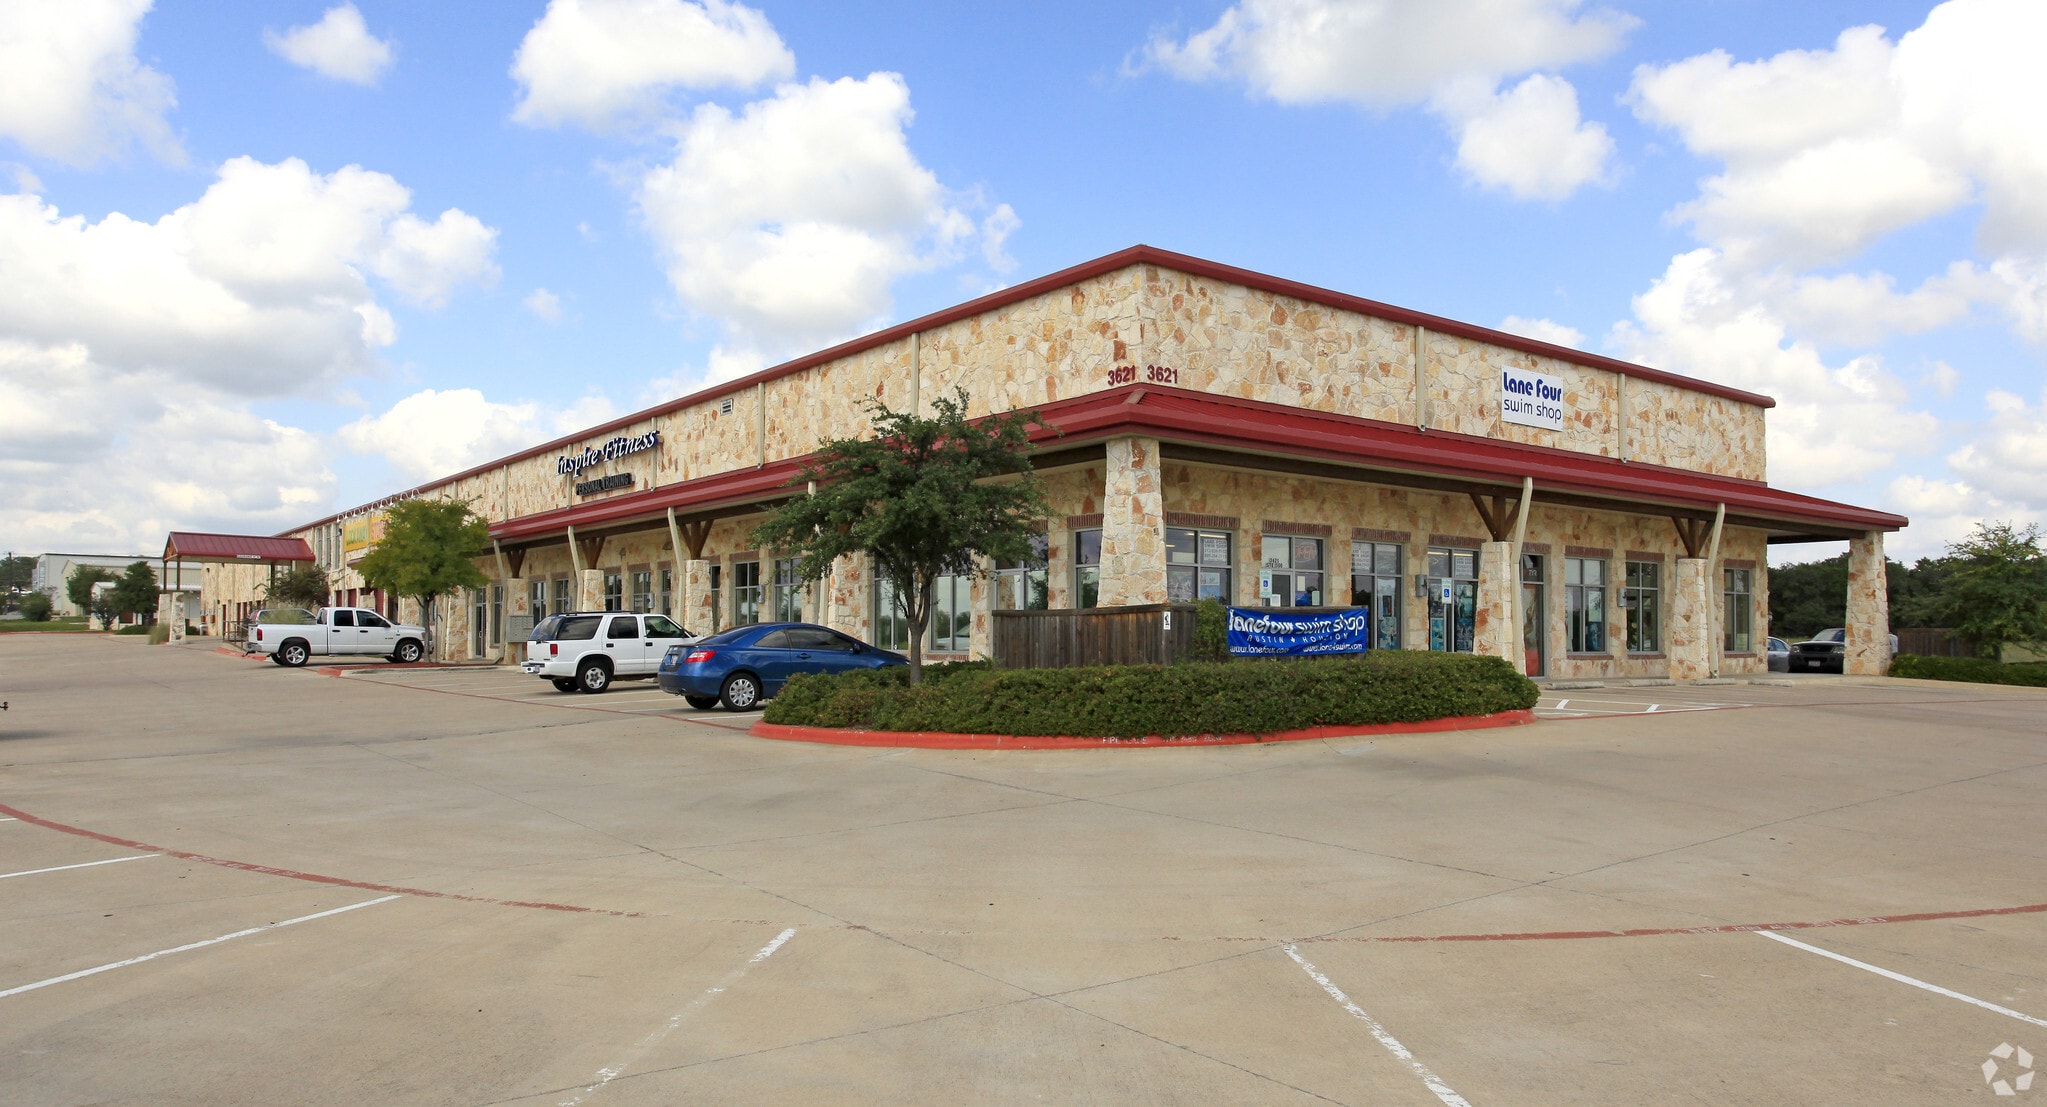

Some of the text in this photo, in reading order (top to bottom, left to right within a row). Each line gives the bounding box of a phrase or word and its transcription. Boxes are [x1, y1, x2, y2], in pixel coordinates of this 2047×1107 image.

[1107, 365, 1136, 386] 3621
[1147, 364, 1178, 384] 3621
[1503, 371, 1562, 402] lane four
[1504, 398, 1562, 424] swim shop
[556, 430, 660, 478] Inspire Fitness
[602, 473, 632, 490] TRAINING
[1295, 617, 1331, 634] swim
[1333, 613, 1365, 636] shop
[1247, 634, 1284, 643] AUSTIN
